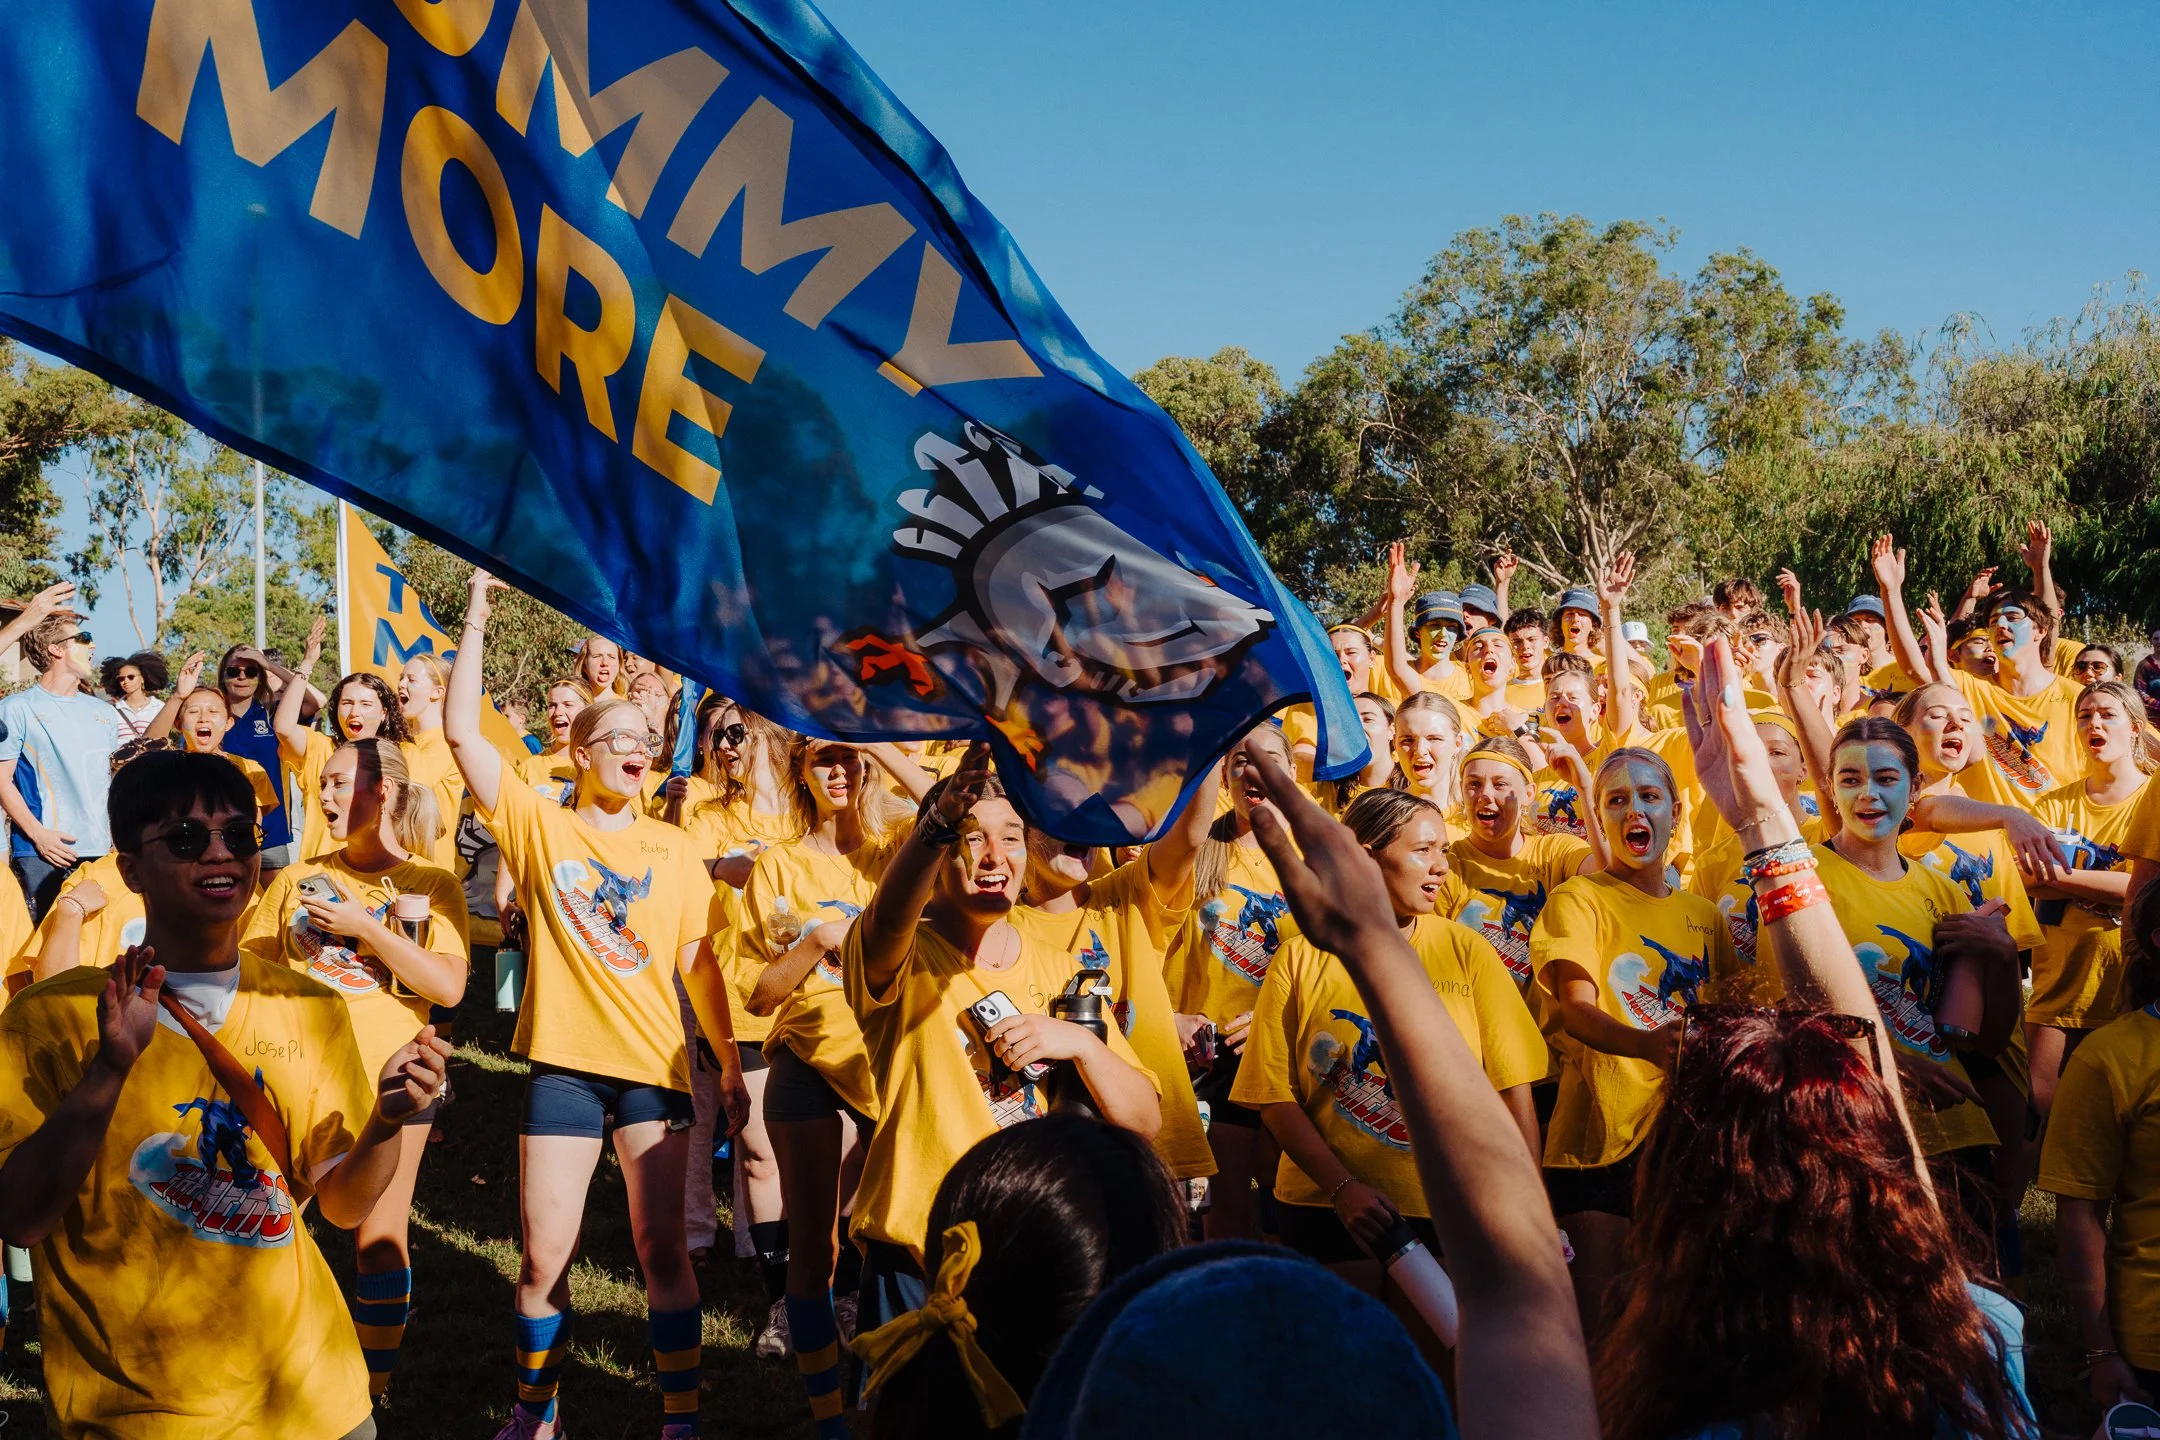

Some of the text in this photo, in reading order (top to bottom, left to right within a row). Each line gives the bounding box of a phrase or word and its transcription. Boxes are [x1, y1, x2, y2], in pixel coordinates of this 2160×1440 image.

[136, 0, 766, 506] MORE
[393, 0, 1045, 398] MMY
[640, 840, 670, 860] Ruby
[1433, 979, 1473, 998] enna
